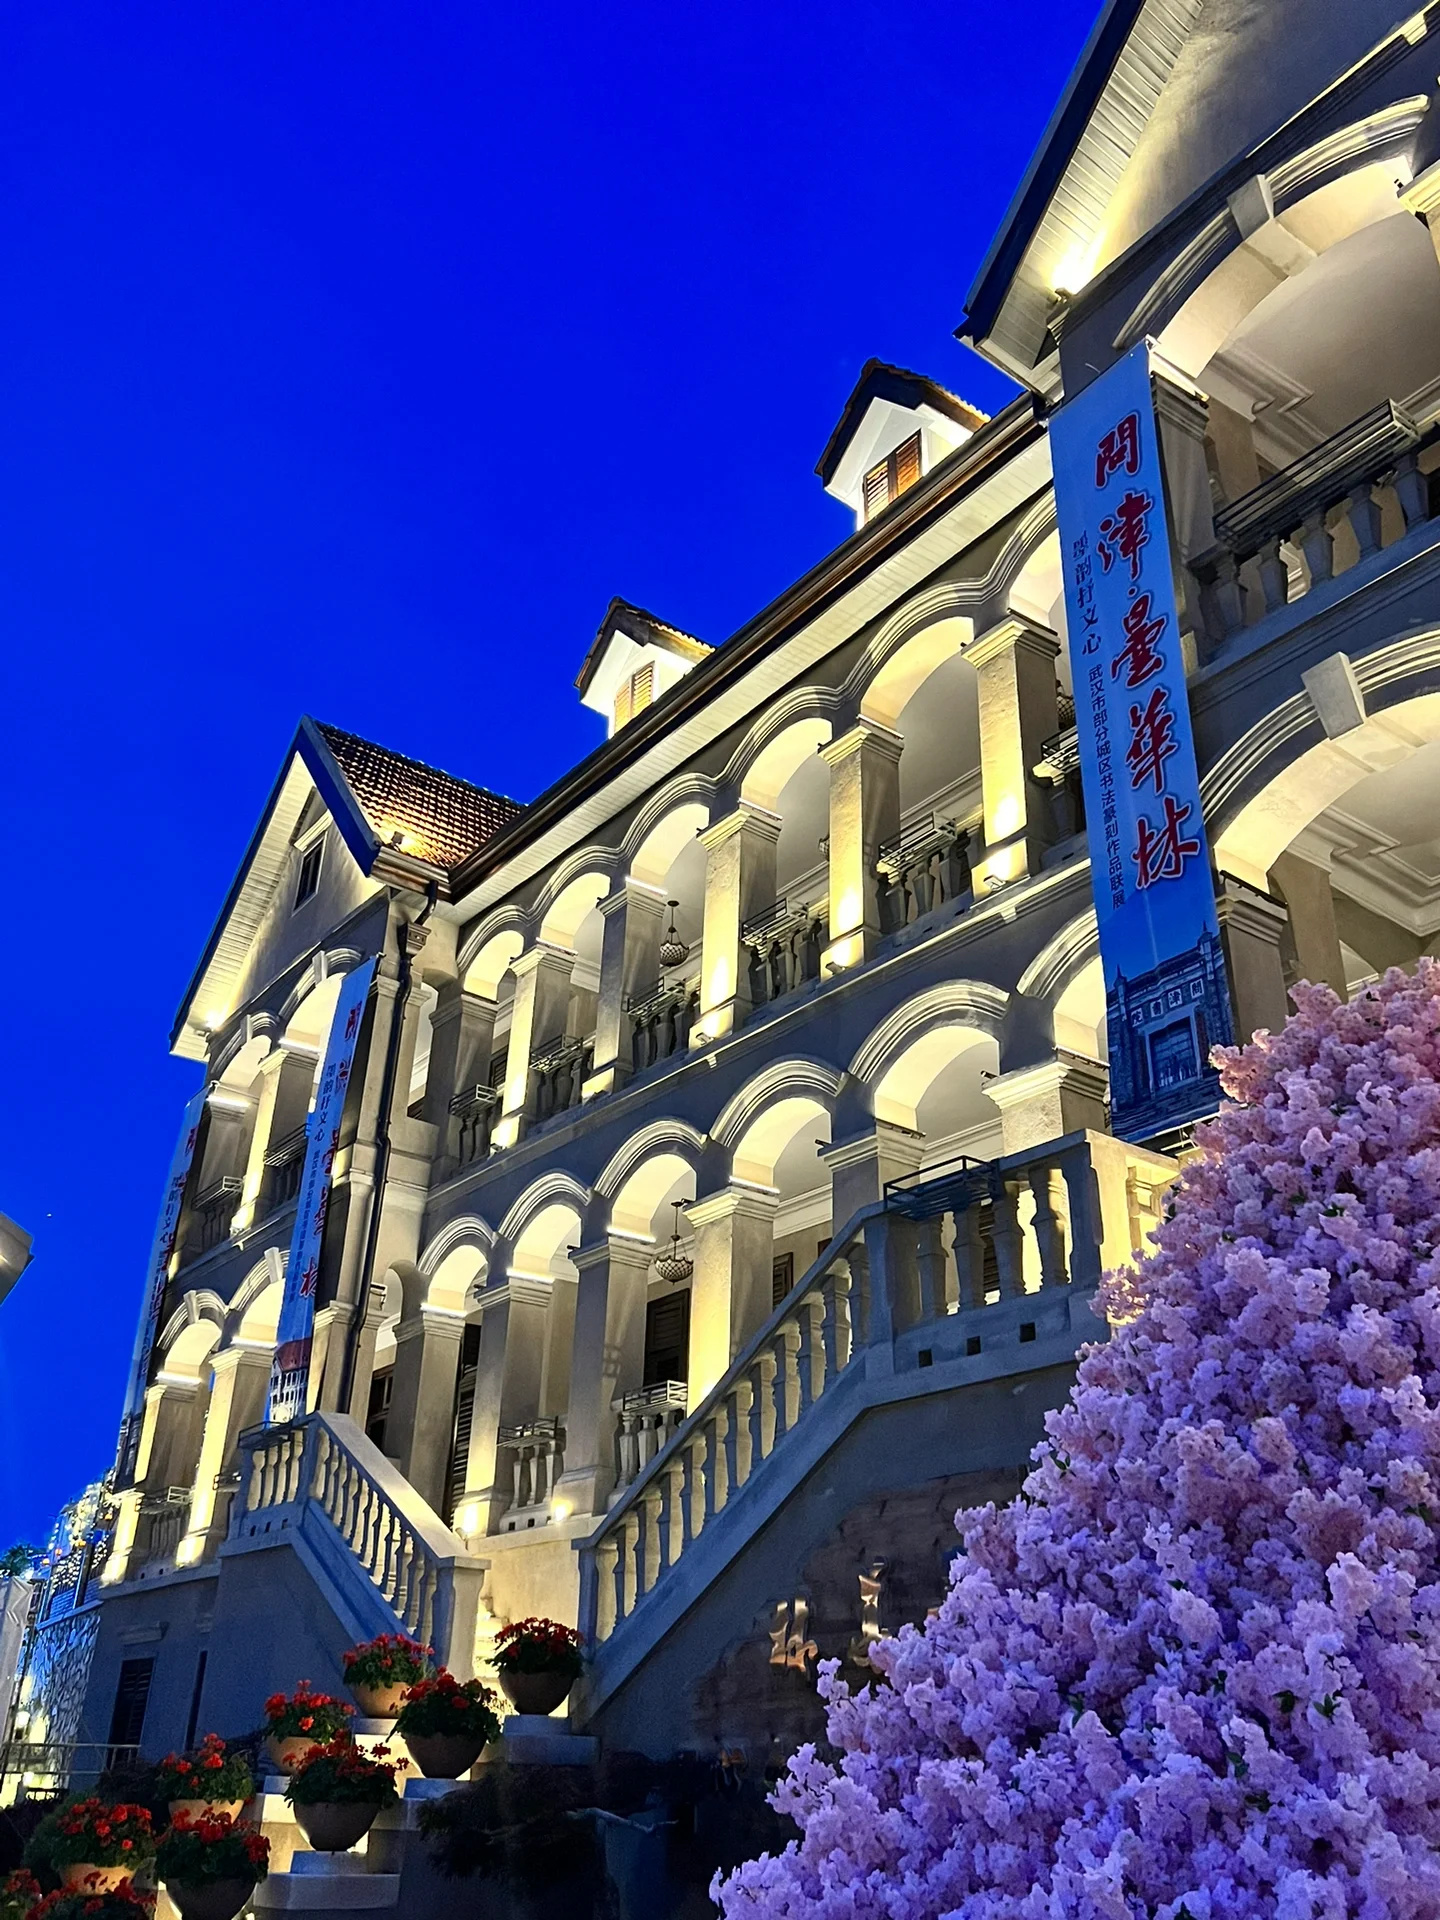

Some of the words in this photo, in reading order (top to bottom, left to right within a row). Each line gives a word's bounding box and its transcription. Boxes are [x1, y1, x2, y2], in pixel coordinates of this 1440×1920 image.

[1088, 664, 1126, 910] 武汉市部分城区书法篆刻作品联展
